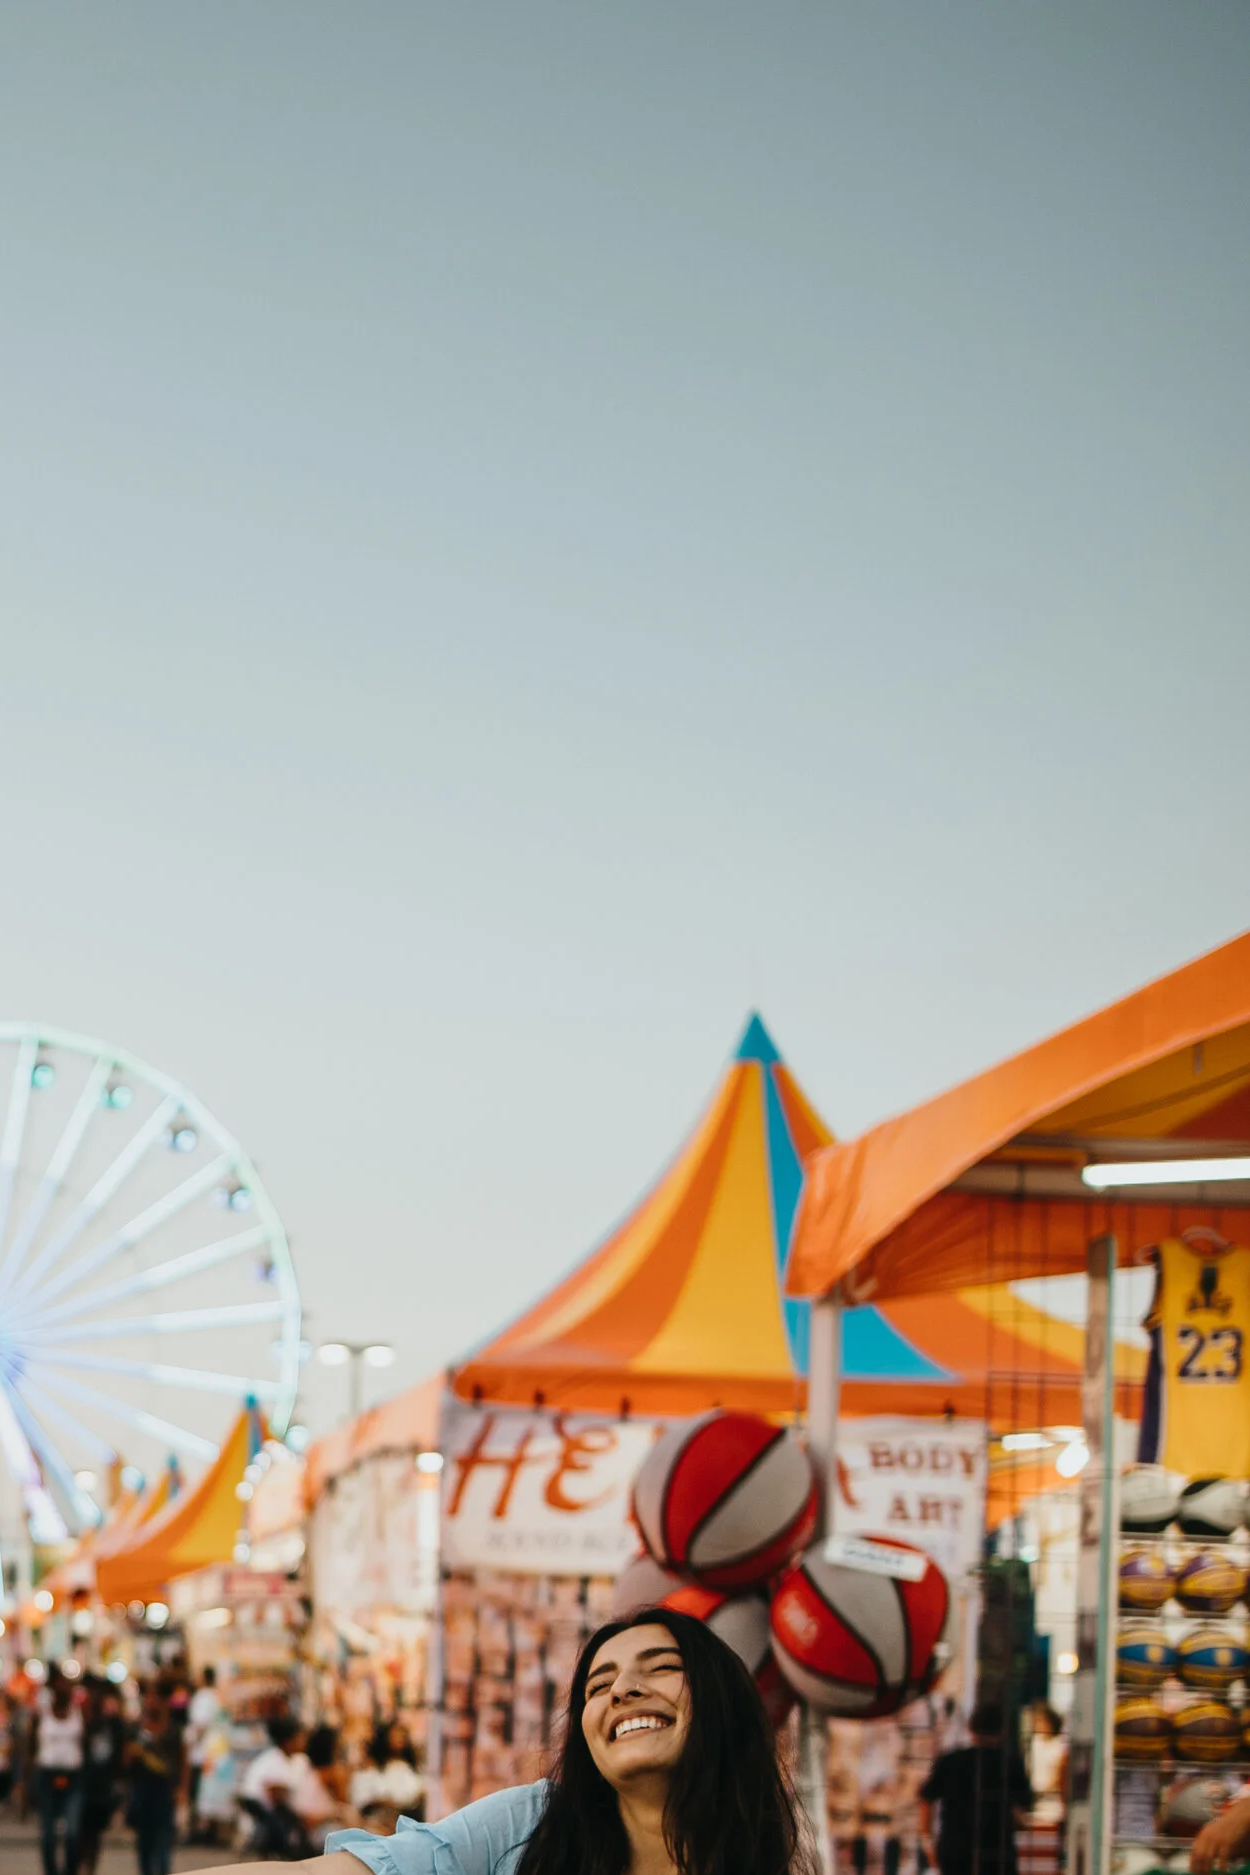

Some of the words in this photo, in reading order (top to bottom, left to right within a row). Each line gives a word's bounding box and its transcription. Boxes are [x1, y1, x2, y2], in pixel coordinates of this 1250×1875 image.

[1177, 1326, 1243, 1384] 23
[446, 1408, 666, 1520] HE
[867, 1440, 981, 1479] BODY
[886, 1491, 964, 1526] ART
